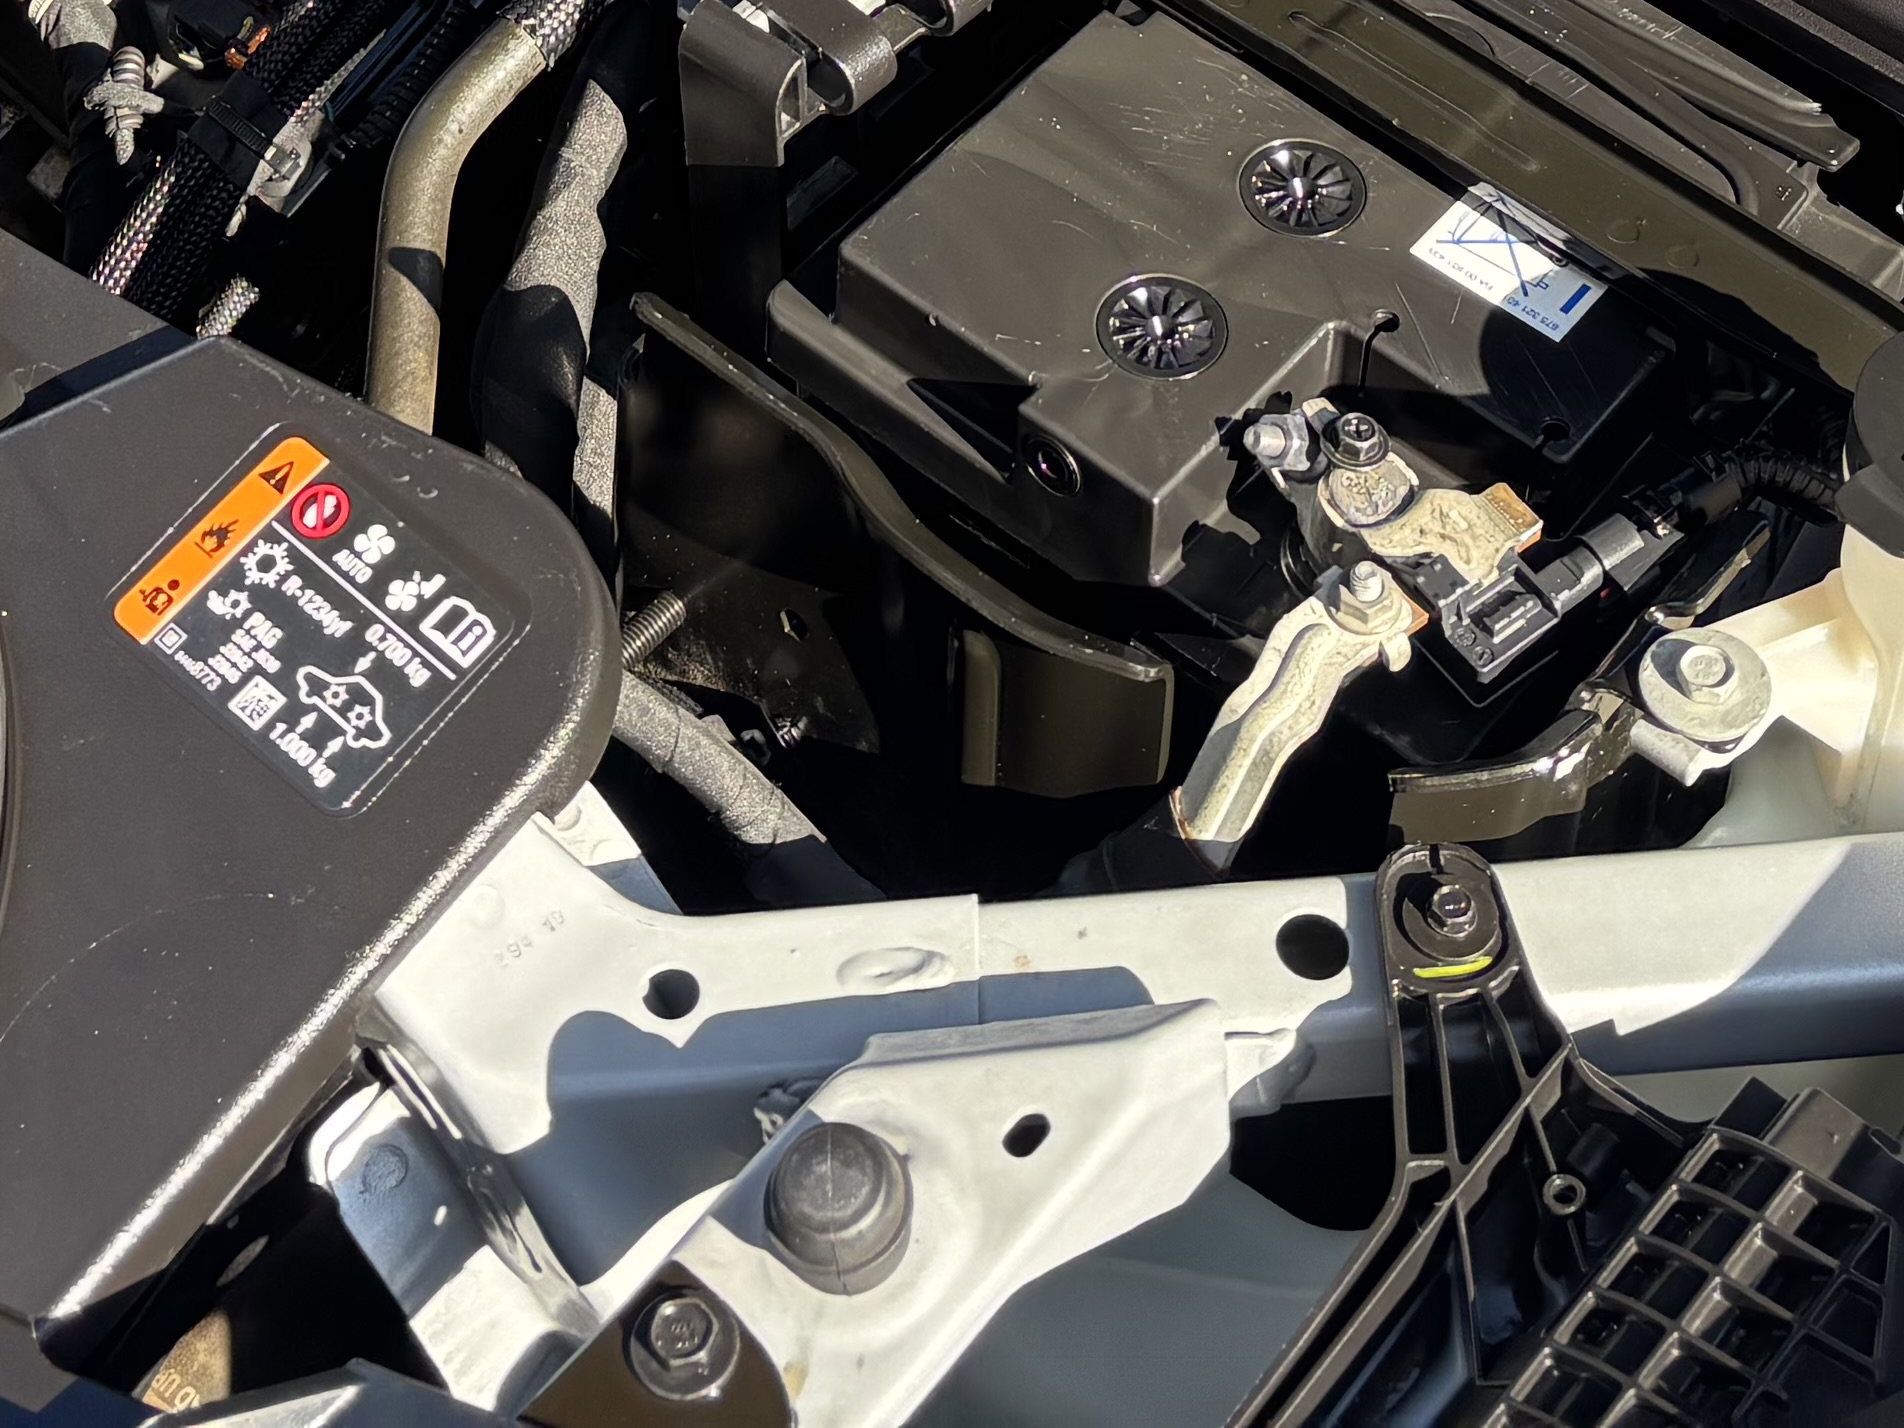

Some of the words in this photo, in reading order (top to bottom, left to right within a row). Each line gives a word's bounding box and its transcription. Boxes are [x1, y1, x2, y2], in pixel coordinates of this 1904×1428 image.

[332, 550, 371, 583] AUTO
[243, 612, 283, 649] PAG
[281, 575, 354, 637] R-1234yf
[231, 629, 257, 652] SAE
[365, 624, 412, 666] 0.700
[404, 658, 431, 687] kg
[269, 723, 317, 766] 1.000
[308, 757, 336, 787] kg
